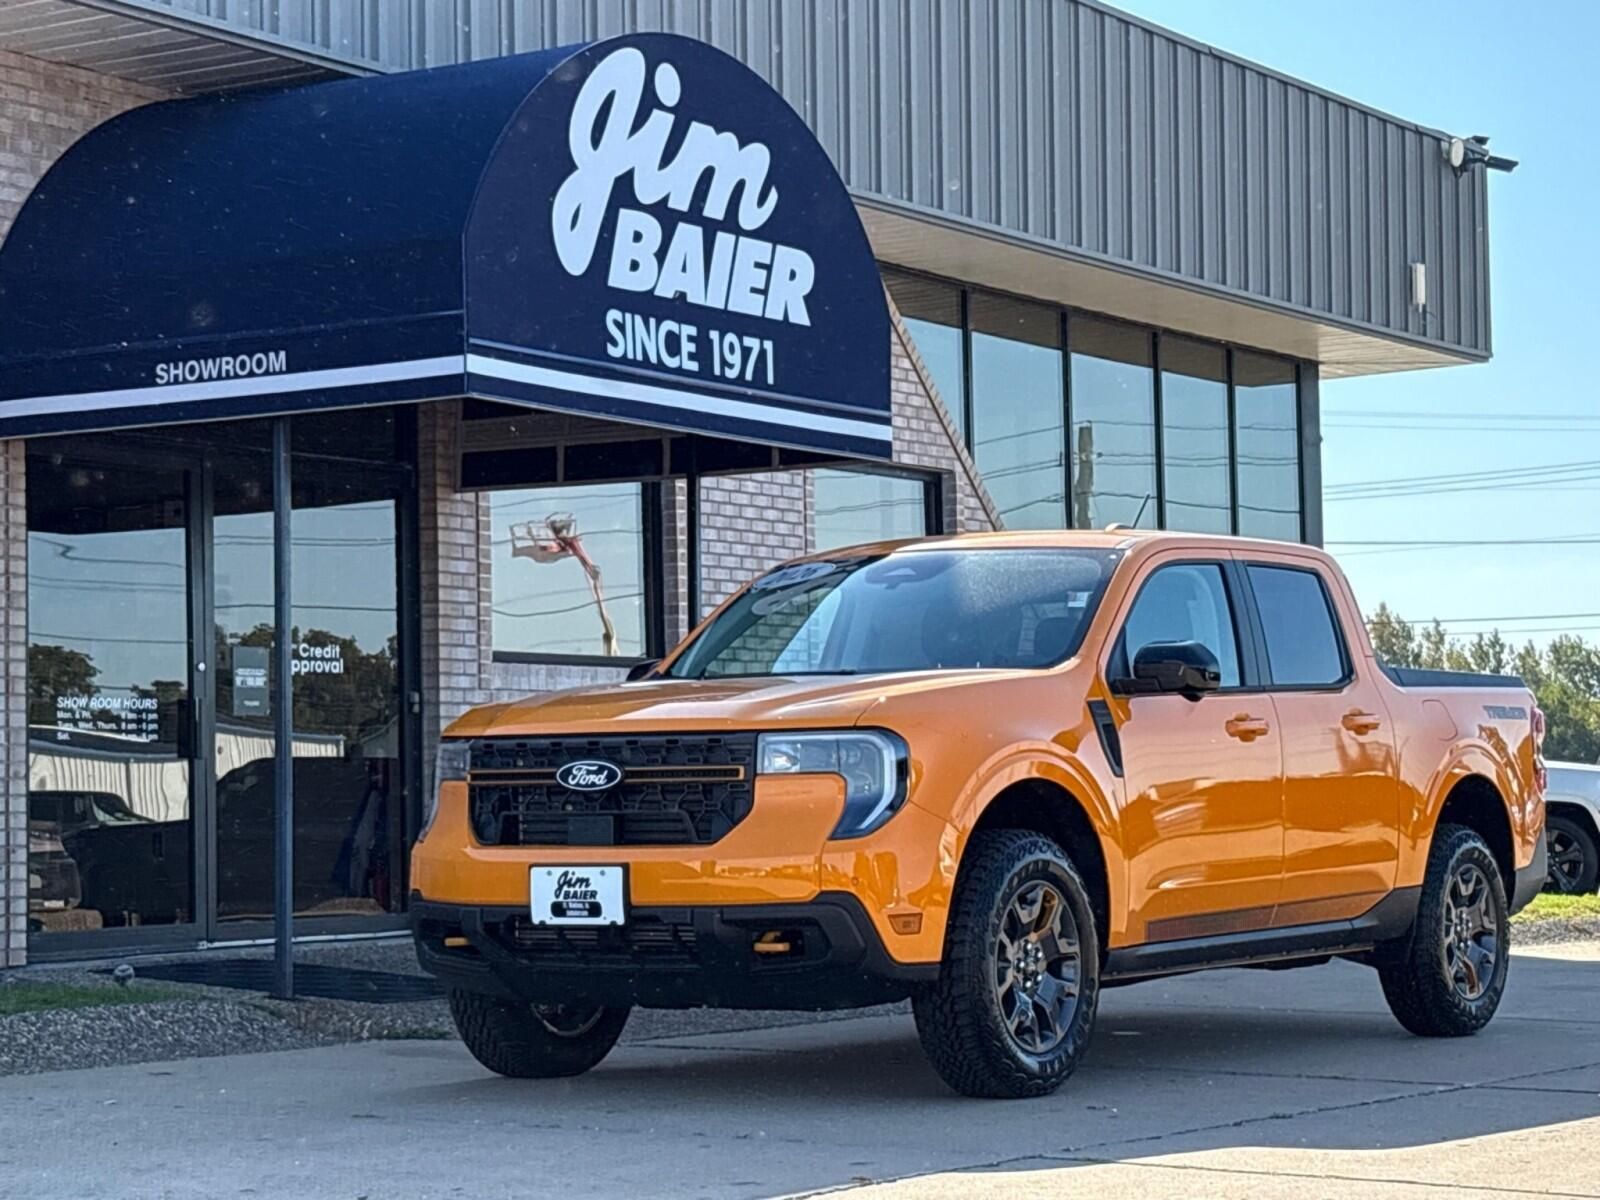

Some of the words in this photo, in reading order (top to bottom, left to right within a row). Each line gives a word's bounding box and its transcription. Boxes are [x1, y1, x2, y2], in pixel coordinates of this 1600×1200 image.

[552, 47, 779, 276] Jim
[607, 208, 815, 326] BAIER
[606, 308, 699, 372] SINCE
[709, 330, 775, 385] 1971
[155, 350, 287, 384] SHOWROOM
[299, 643, 341, 658] Credit
[291, 658, 344, 676] pproval
[56, 696, 88, 709] SHOW
[89, 697, 121, 709] ROOM
[122, 698, 158, 710] HOURS
[568, 765, 608, 785] Ford
[554, 870, 591, 899] Jim
[563, 889, 598, 900] BAIER
